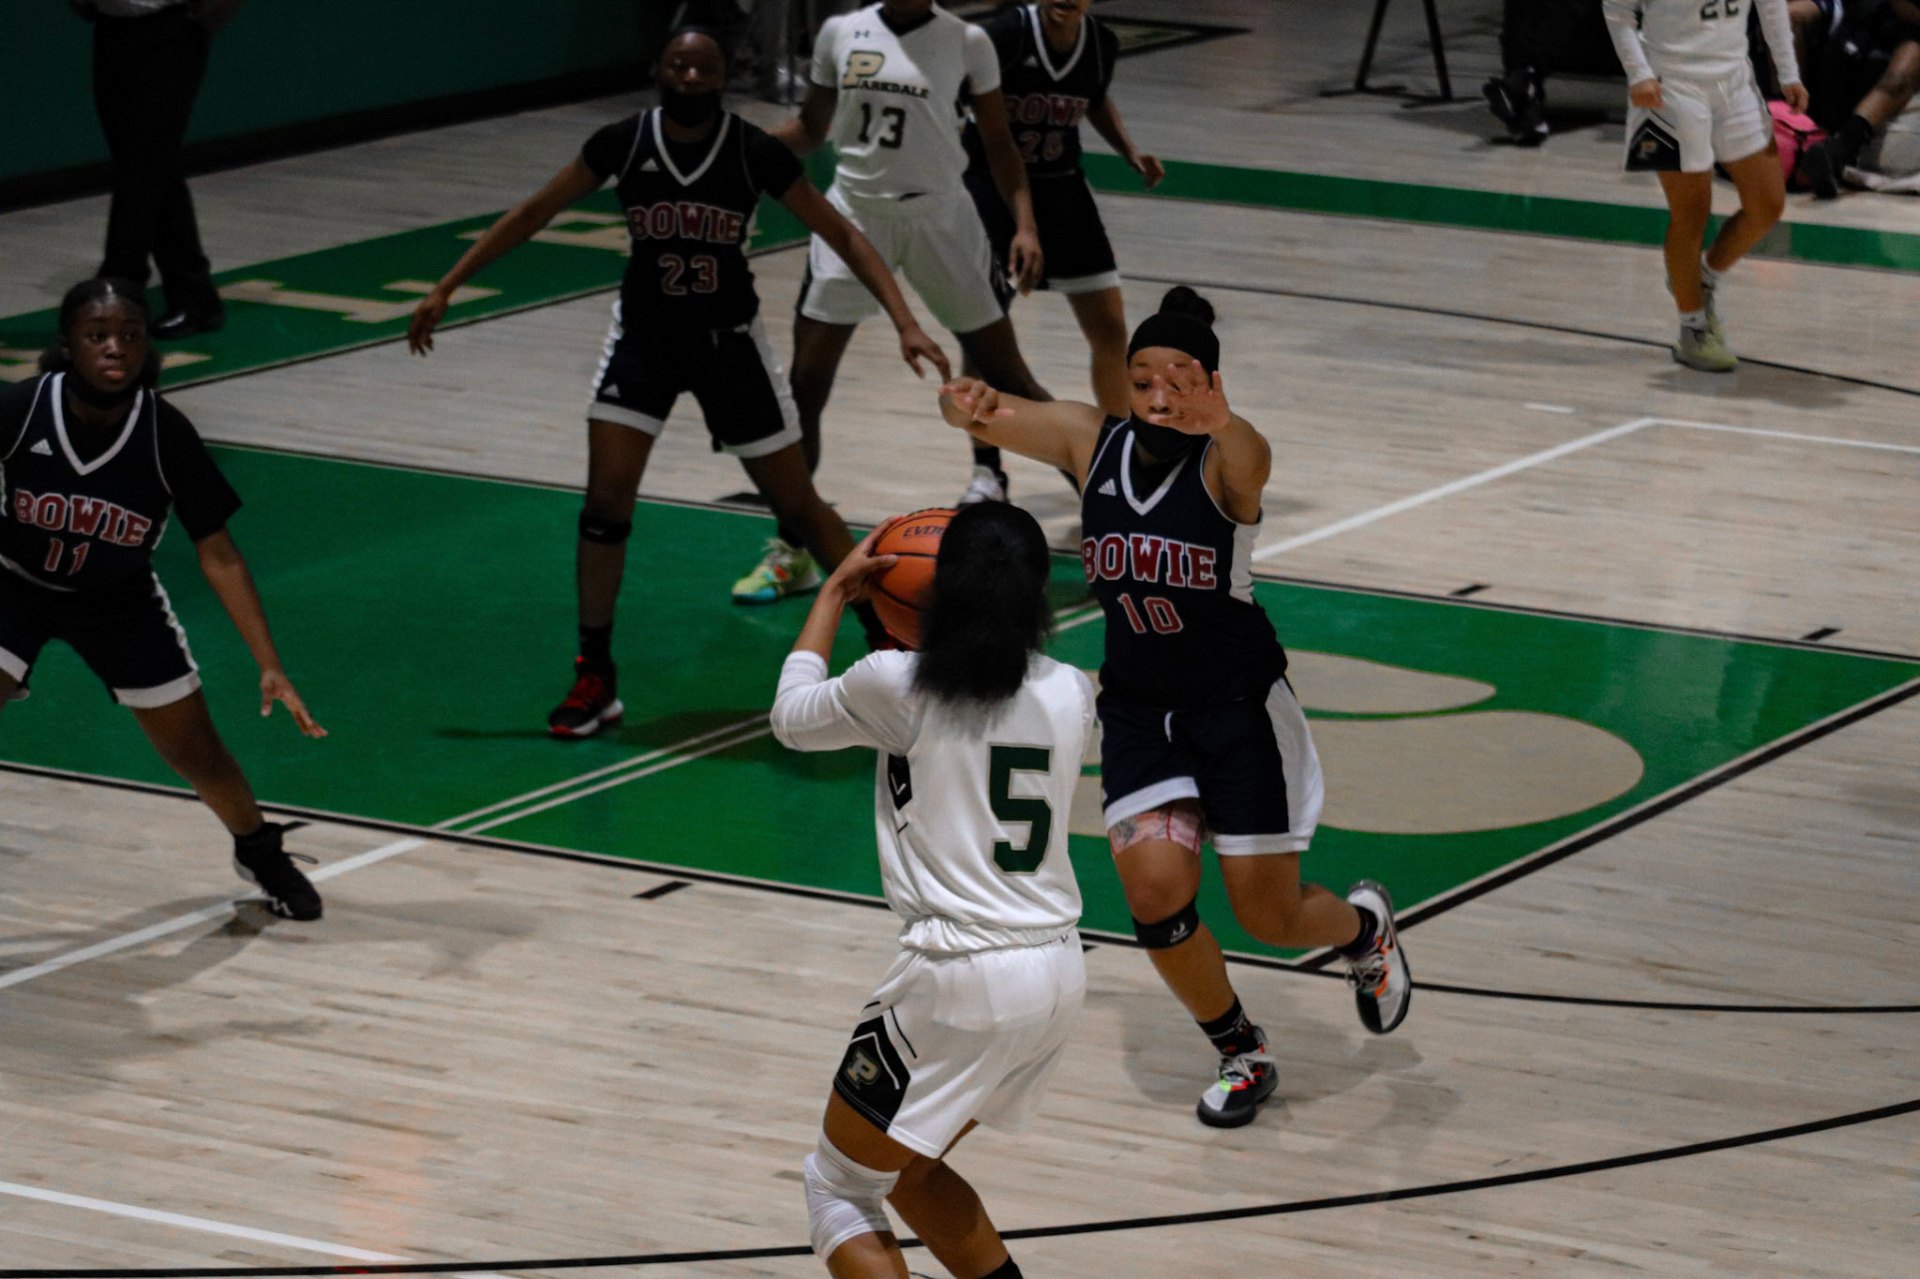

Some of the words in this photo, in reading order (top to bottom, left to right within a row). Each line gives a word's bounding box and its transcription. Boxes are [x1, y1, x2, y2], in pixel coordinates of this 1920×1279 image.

[858, 102, 906, 150] 13
[627, 201, 745, 245] BOWIE
[658, 254, 718, 296] 23
[15, 488, 151, 546] BOWIE
[45, 538, 89, 575] 11
[1083, 533, 1216, 589] BOWIE
[1117, 592, 1184, 634] 10
[989, 743, 1053, 875] 5
